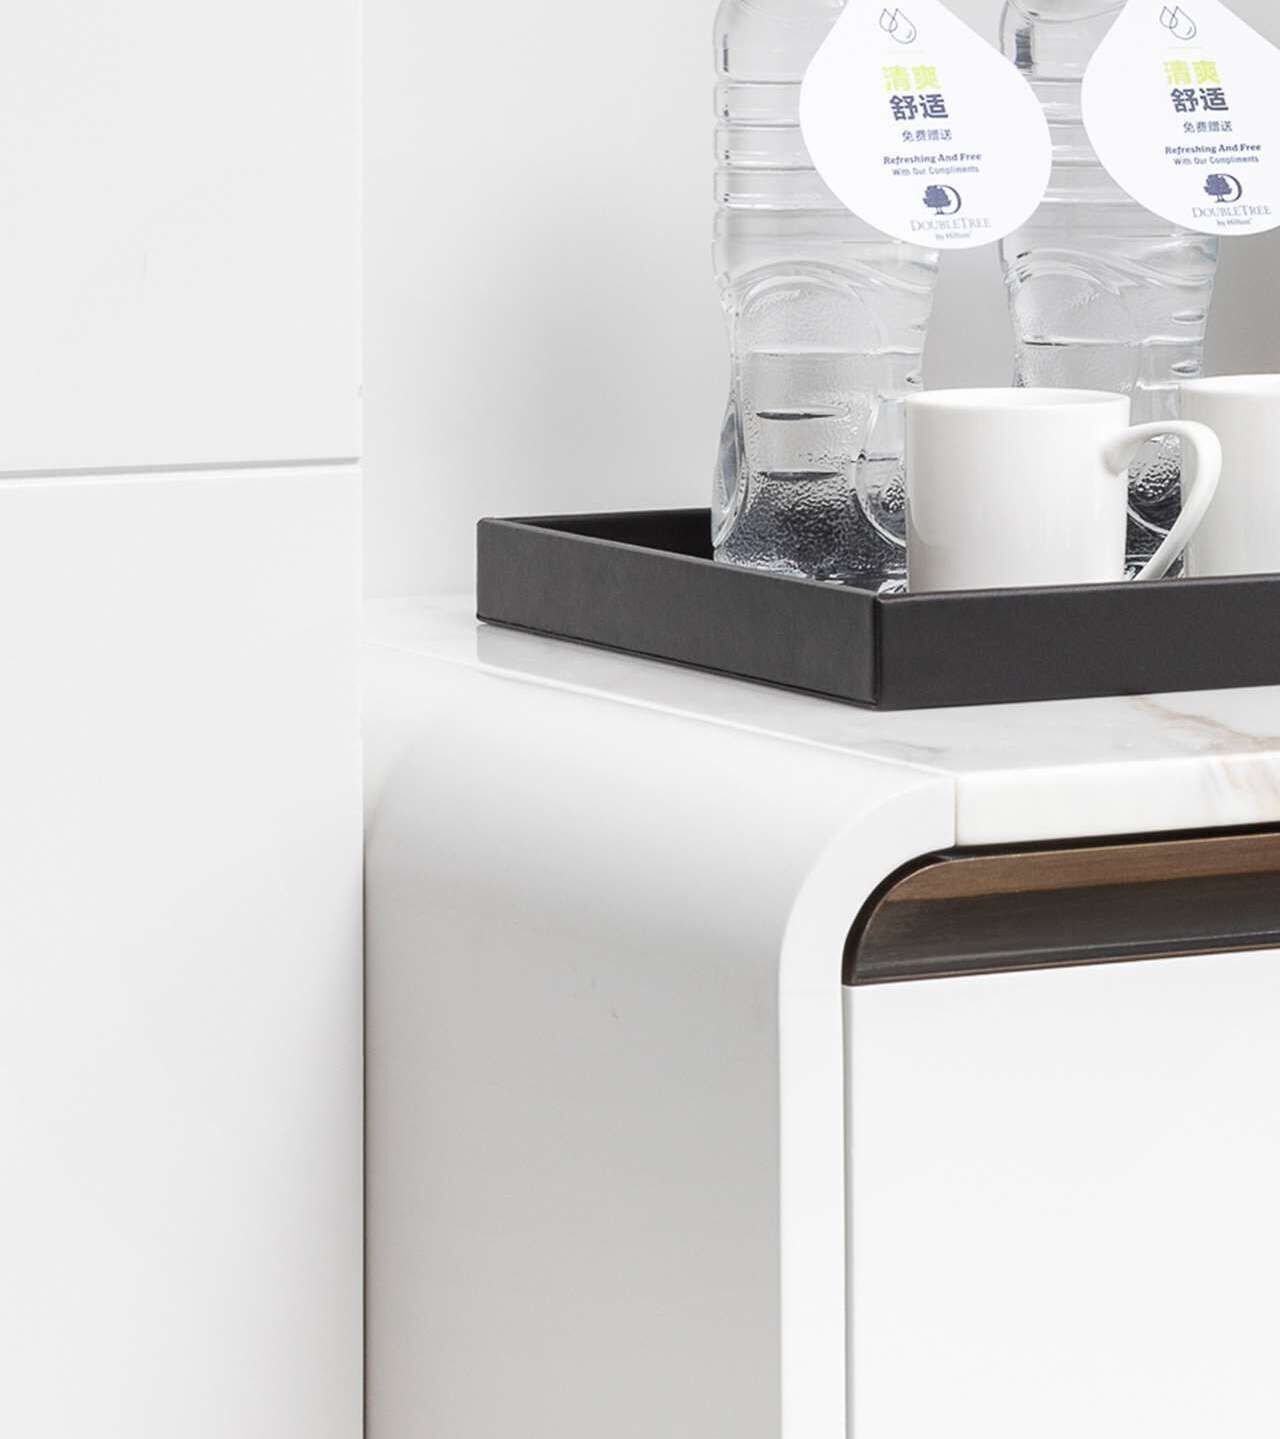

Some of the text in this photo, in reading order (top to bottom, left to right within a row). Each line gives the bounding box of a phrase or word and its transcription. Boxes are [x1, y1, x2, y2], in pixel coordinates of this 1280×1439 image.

[882, 64, 942, 92] 清爽
[1162, 60, 1221, 85] 清爽
[889, 93, 949, 121] 舒适
[1170, 87, 1229, 112] 舒适
[883, 152, 982, 165] Refreshing And Free
[1165, 143, 1261, 155] Refreshing And Free
